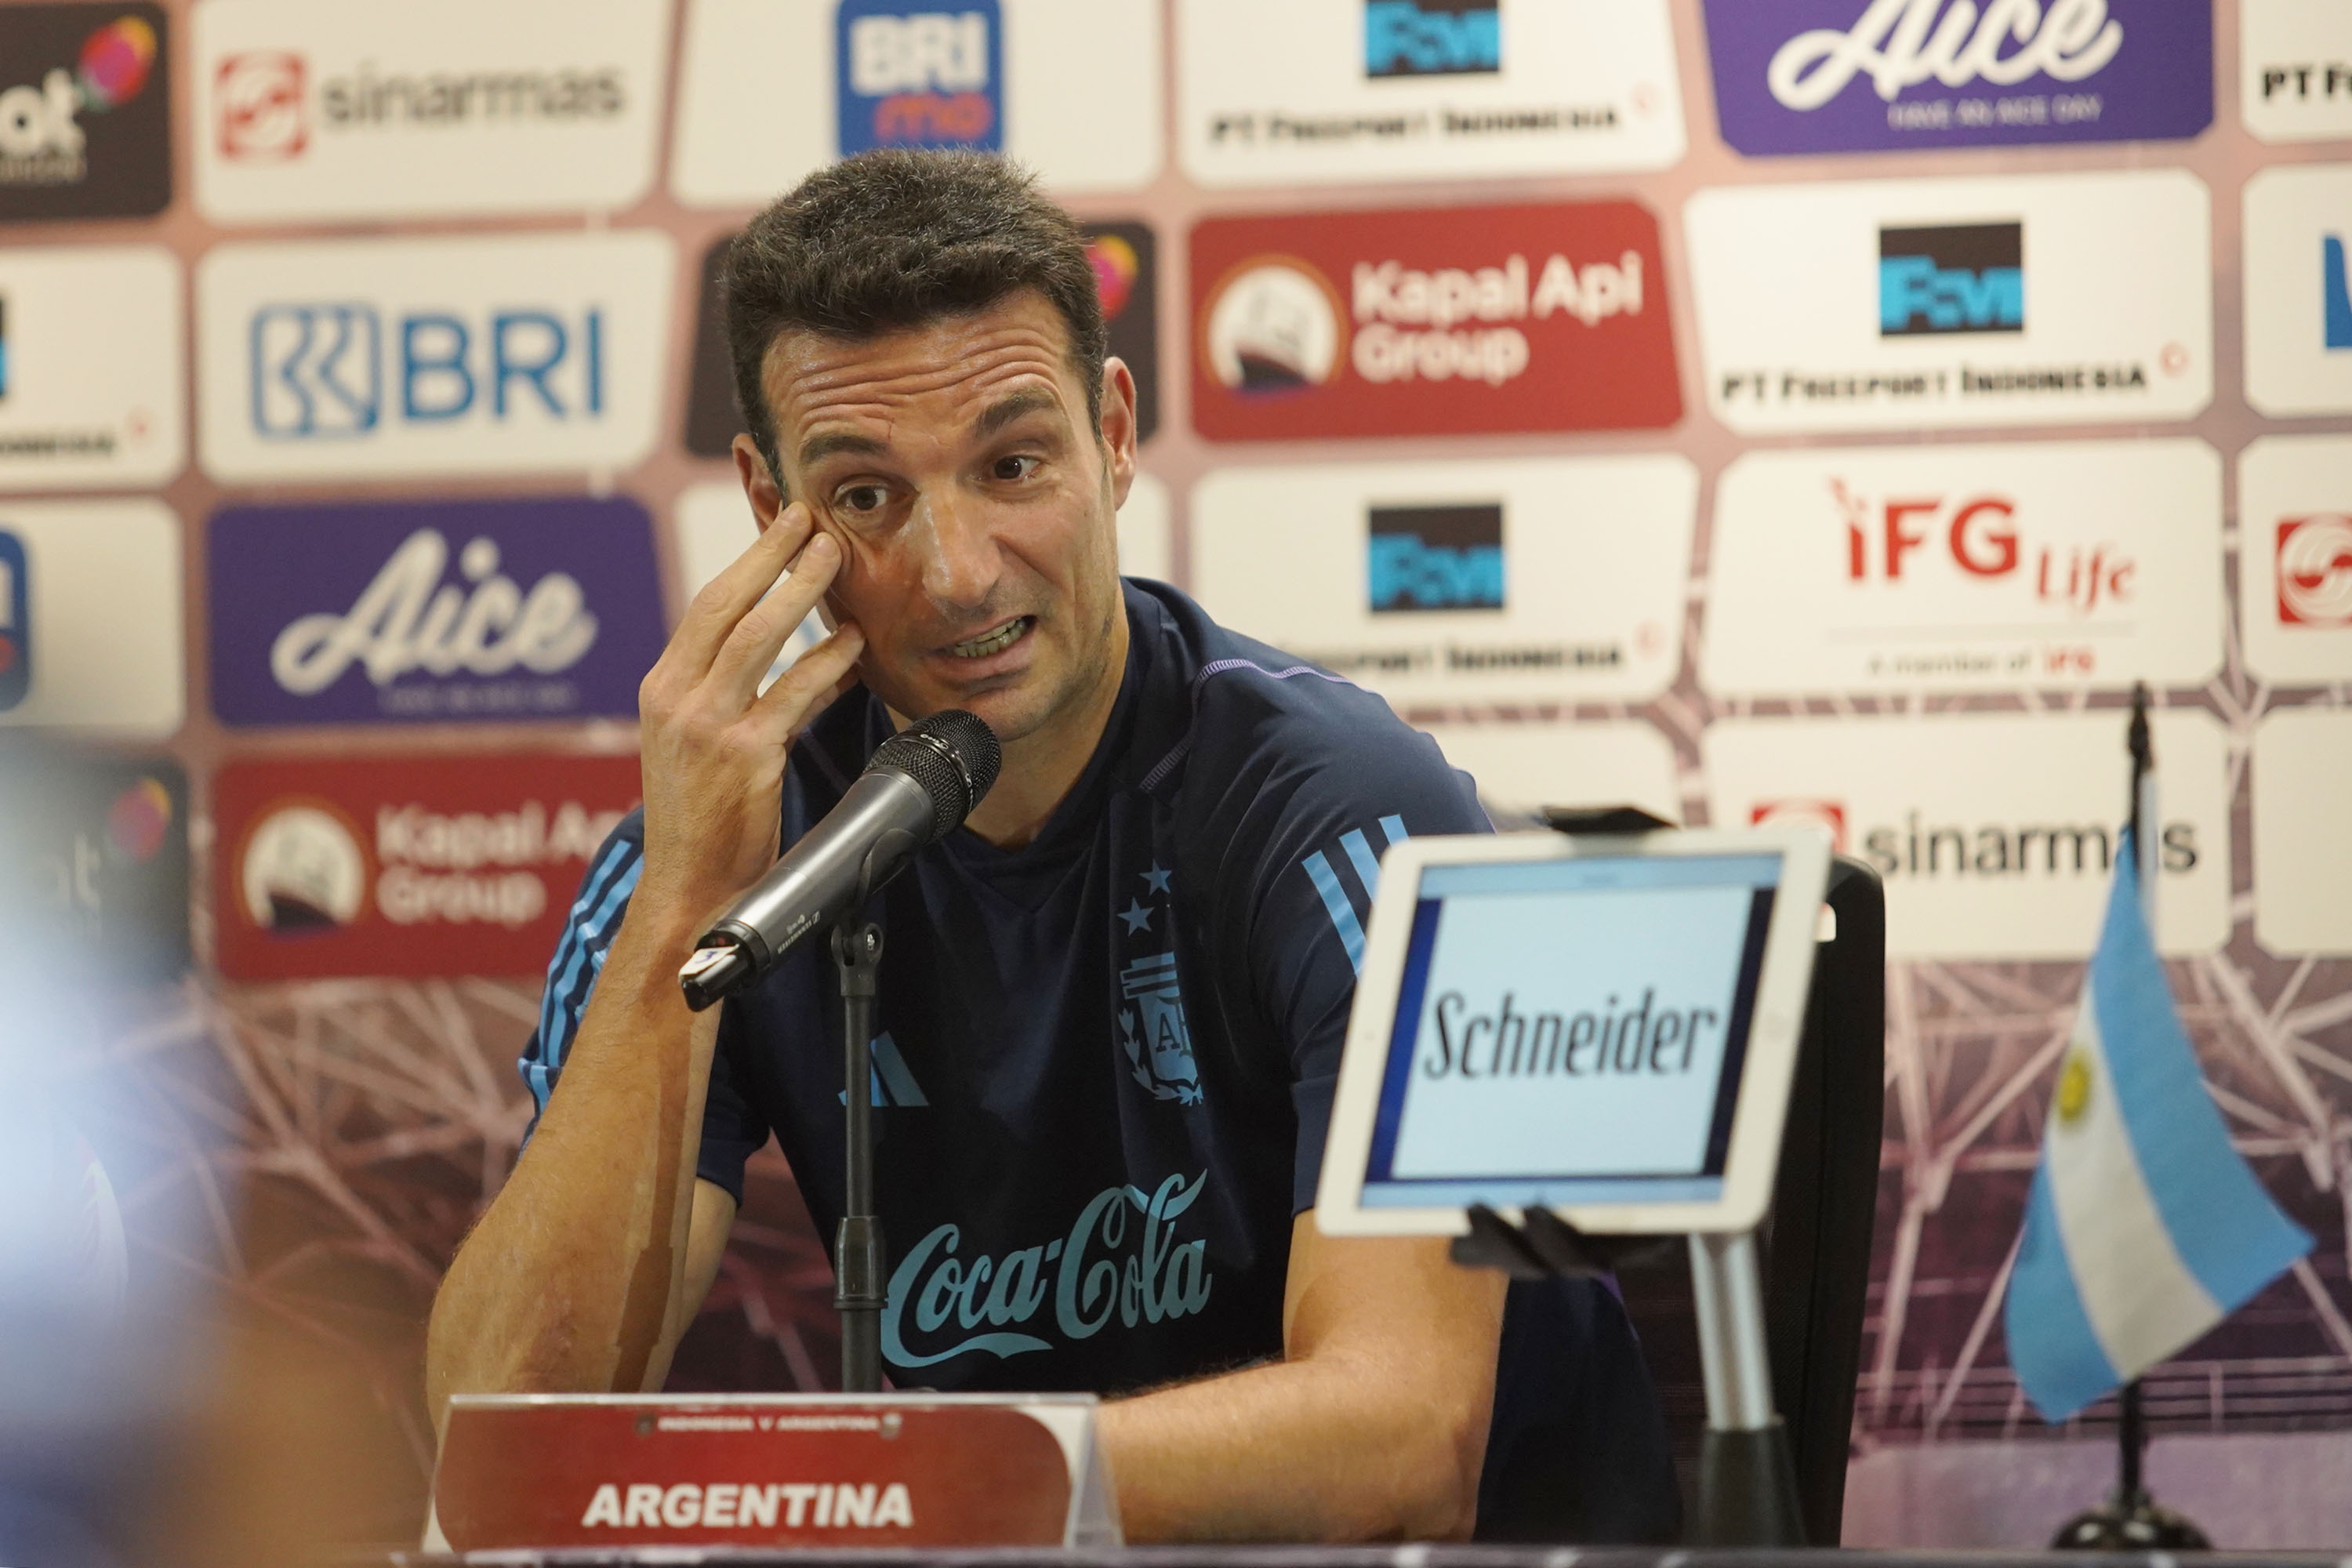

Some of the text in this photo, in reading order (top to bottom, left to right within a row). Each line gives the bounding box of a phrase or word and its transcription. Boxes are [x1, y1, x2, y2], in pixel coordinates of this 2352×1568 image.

[852, 13, 988, 94] BRI
[1769, 0, 2122, 111] Aice
[2262, 66, 2311, 100] PT
[323, 58, 622, 125] sinarmas
[1352, 250, 1643, 327] Kapal Api
[400, 310, 604, 422] BRI
[1352, 325, 1530, 384] Group
[272, 531, 596, 693] Aice
[378, 801, 546, 870] Kapal
[1866, 810, 2198, 877] sinarms
[378, 867, 546, 927] Group
[1424, 986, 1718, 1080] Schneider
[880, 1168, 1213, 1368] Coca-Cola
[658, 1416, 754, 1432] INDONESIA
[777, 1415, 880, 1432] ARGENTINA
[582, 1483, 913, 1528] ARGENTINA
